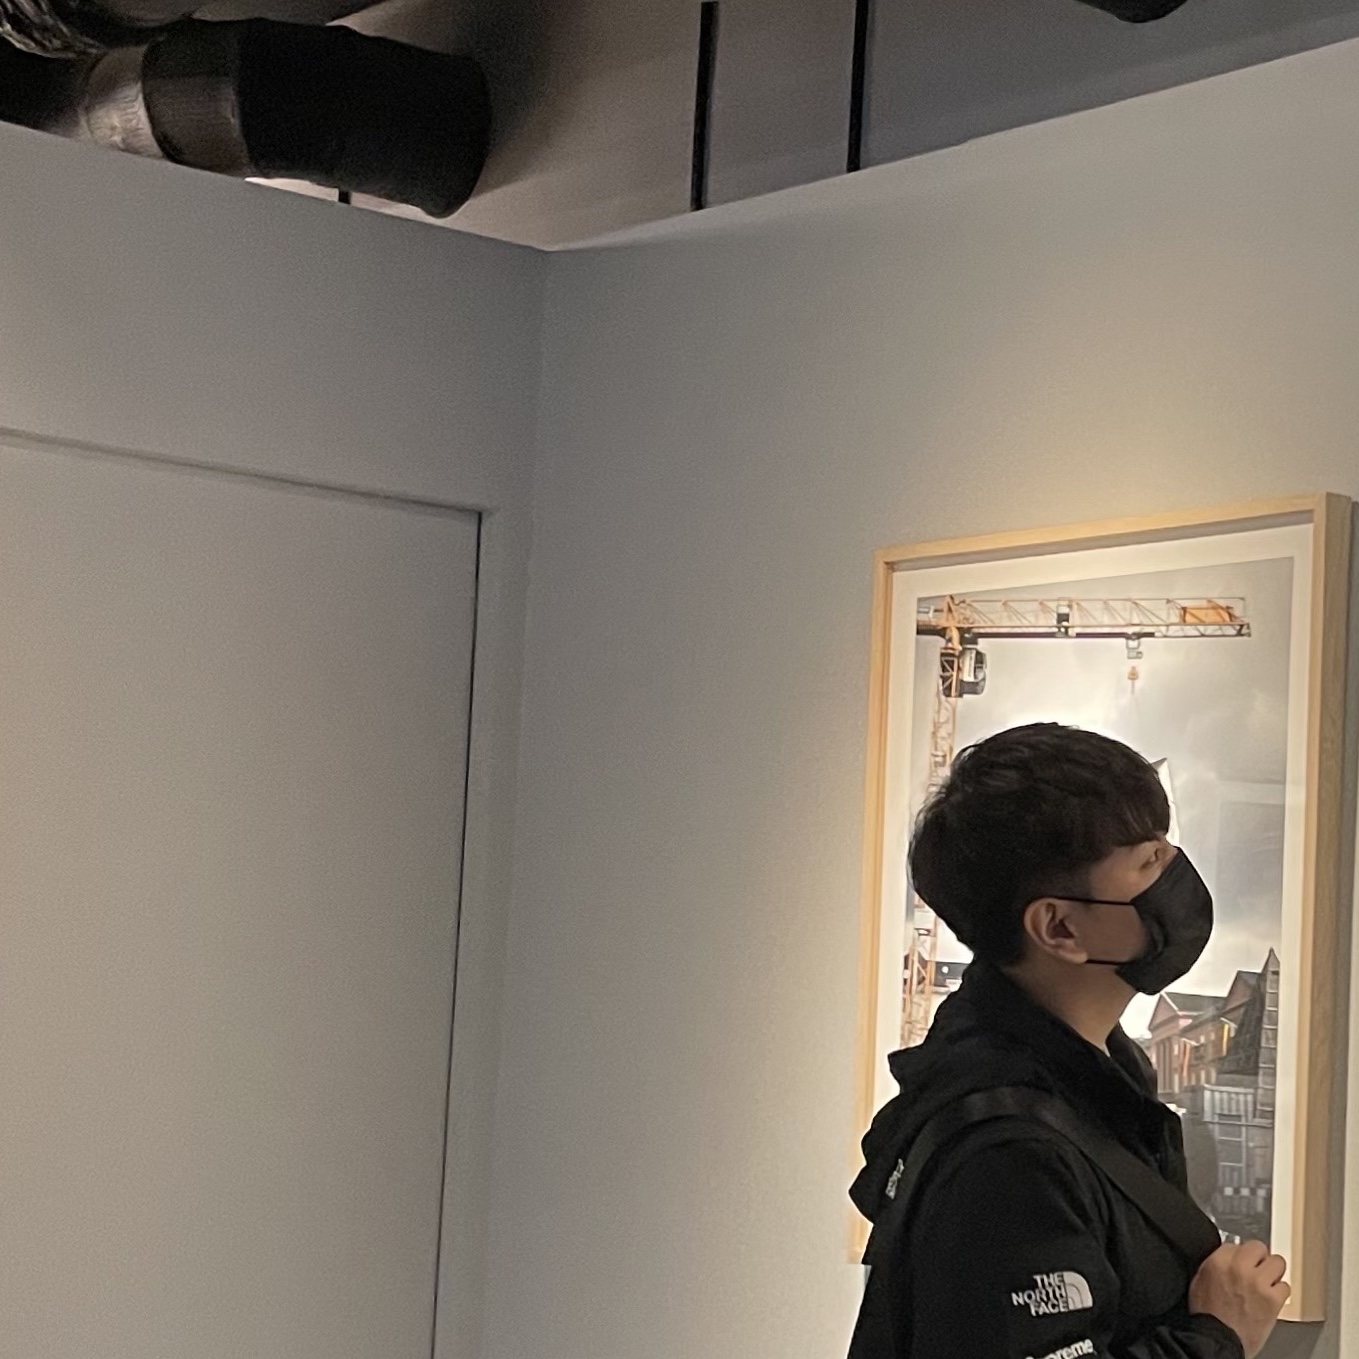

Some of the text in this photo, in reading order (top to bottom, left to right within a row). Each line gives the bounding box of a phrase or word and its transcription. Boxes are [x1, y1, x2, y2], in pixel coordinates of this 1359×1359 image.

[1033, 1271, 1064, 1289] THE
[1011, 1283, 1067, 1306] NORTH
[1029, 1299, 1070, 1317] FACE
